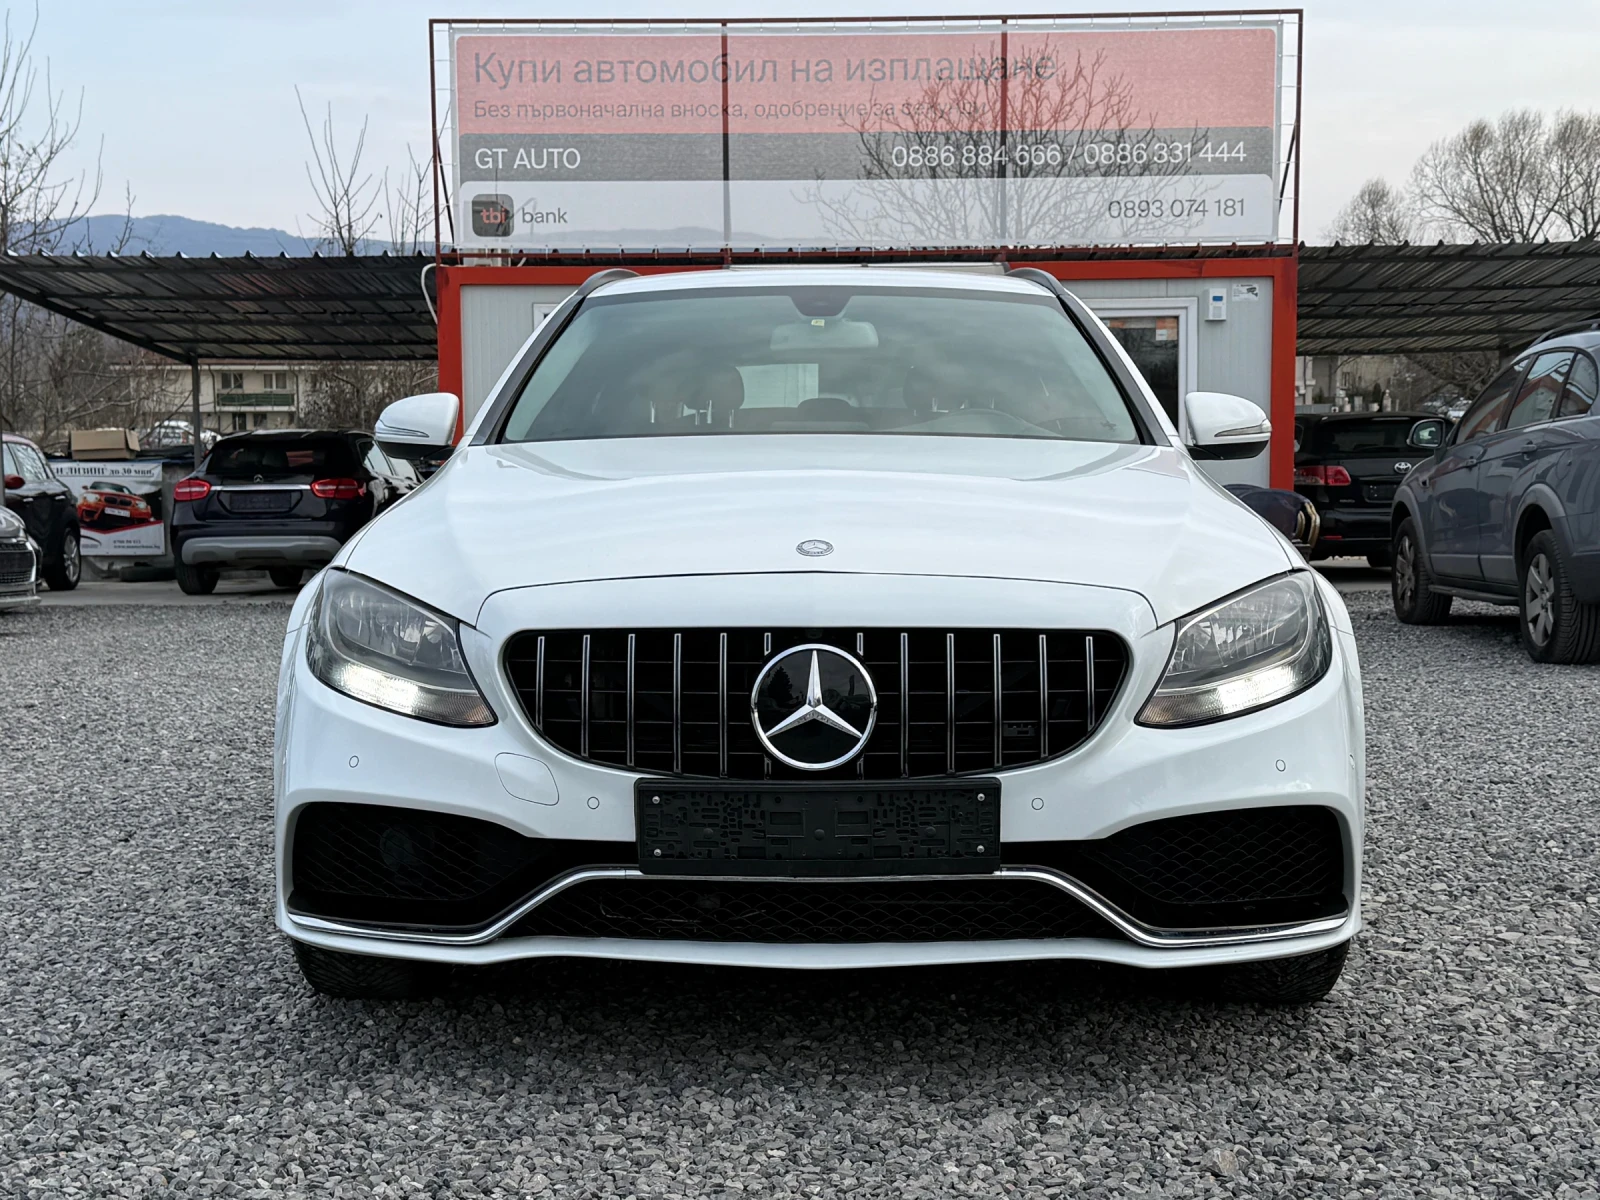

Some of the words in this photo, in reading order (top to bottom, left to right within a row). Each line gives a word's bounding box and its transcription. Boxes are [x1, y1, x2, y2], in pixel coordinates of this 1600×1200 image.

[474, 52, 561, 89] Купи
[573, 52, 777, 83] автомобил
[791, 57, 833, 82] на
[846, 54, 1056, 86] изплащане
[474, 100, 511, 118] Без
[517, 103, 664, 121] първоначална
[671, 102, 748, 120] вноска,
[754, 101, 869, 120] одобрение
[873, 102, 896, 117] за
[474, 147, 508, 169] GT
[513, 147, 581, 169] AUTO
[891, 145, 955, 167] 0886
[961, 144, 1009, 166] 884
[1015, 144, 1061, 166] 666
[1083, 142, 1147, 165] 0886
[1153, 142, 1192, 163] 331
[1198, 141, 1247, 162] 444
[480, 203, 507, 225] tbi
[521, 207, 568, 224] bank
[1108, 199, 1164, 219] 0893
[1170, 198, 1209, 218] 074
[1214, 198, 1245, 217] 181
